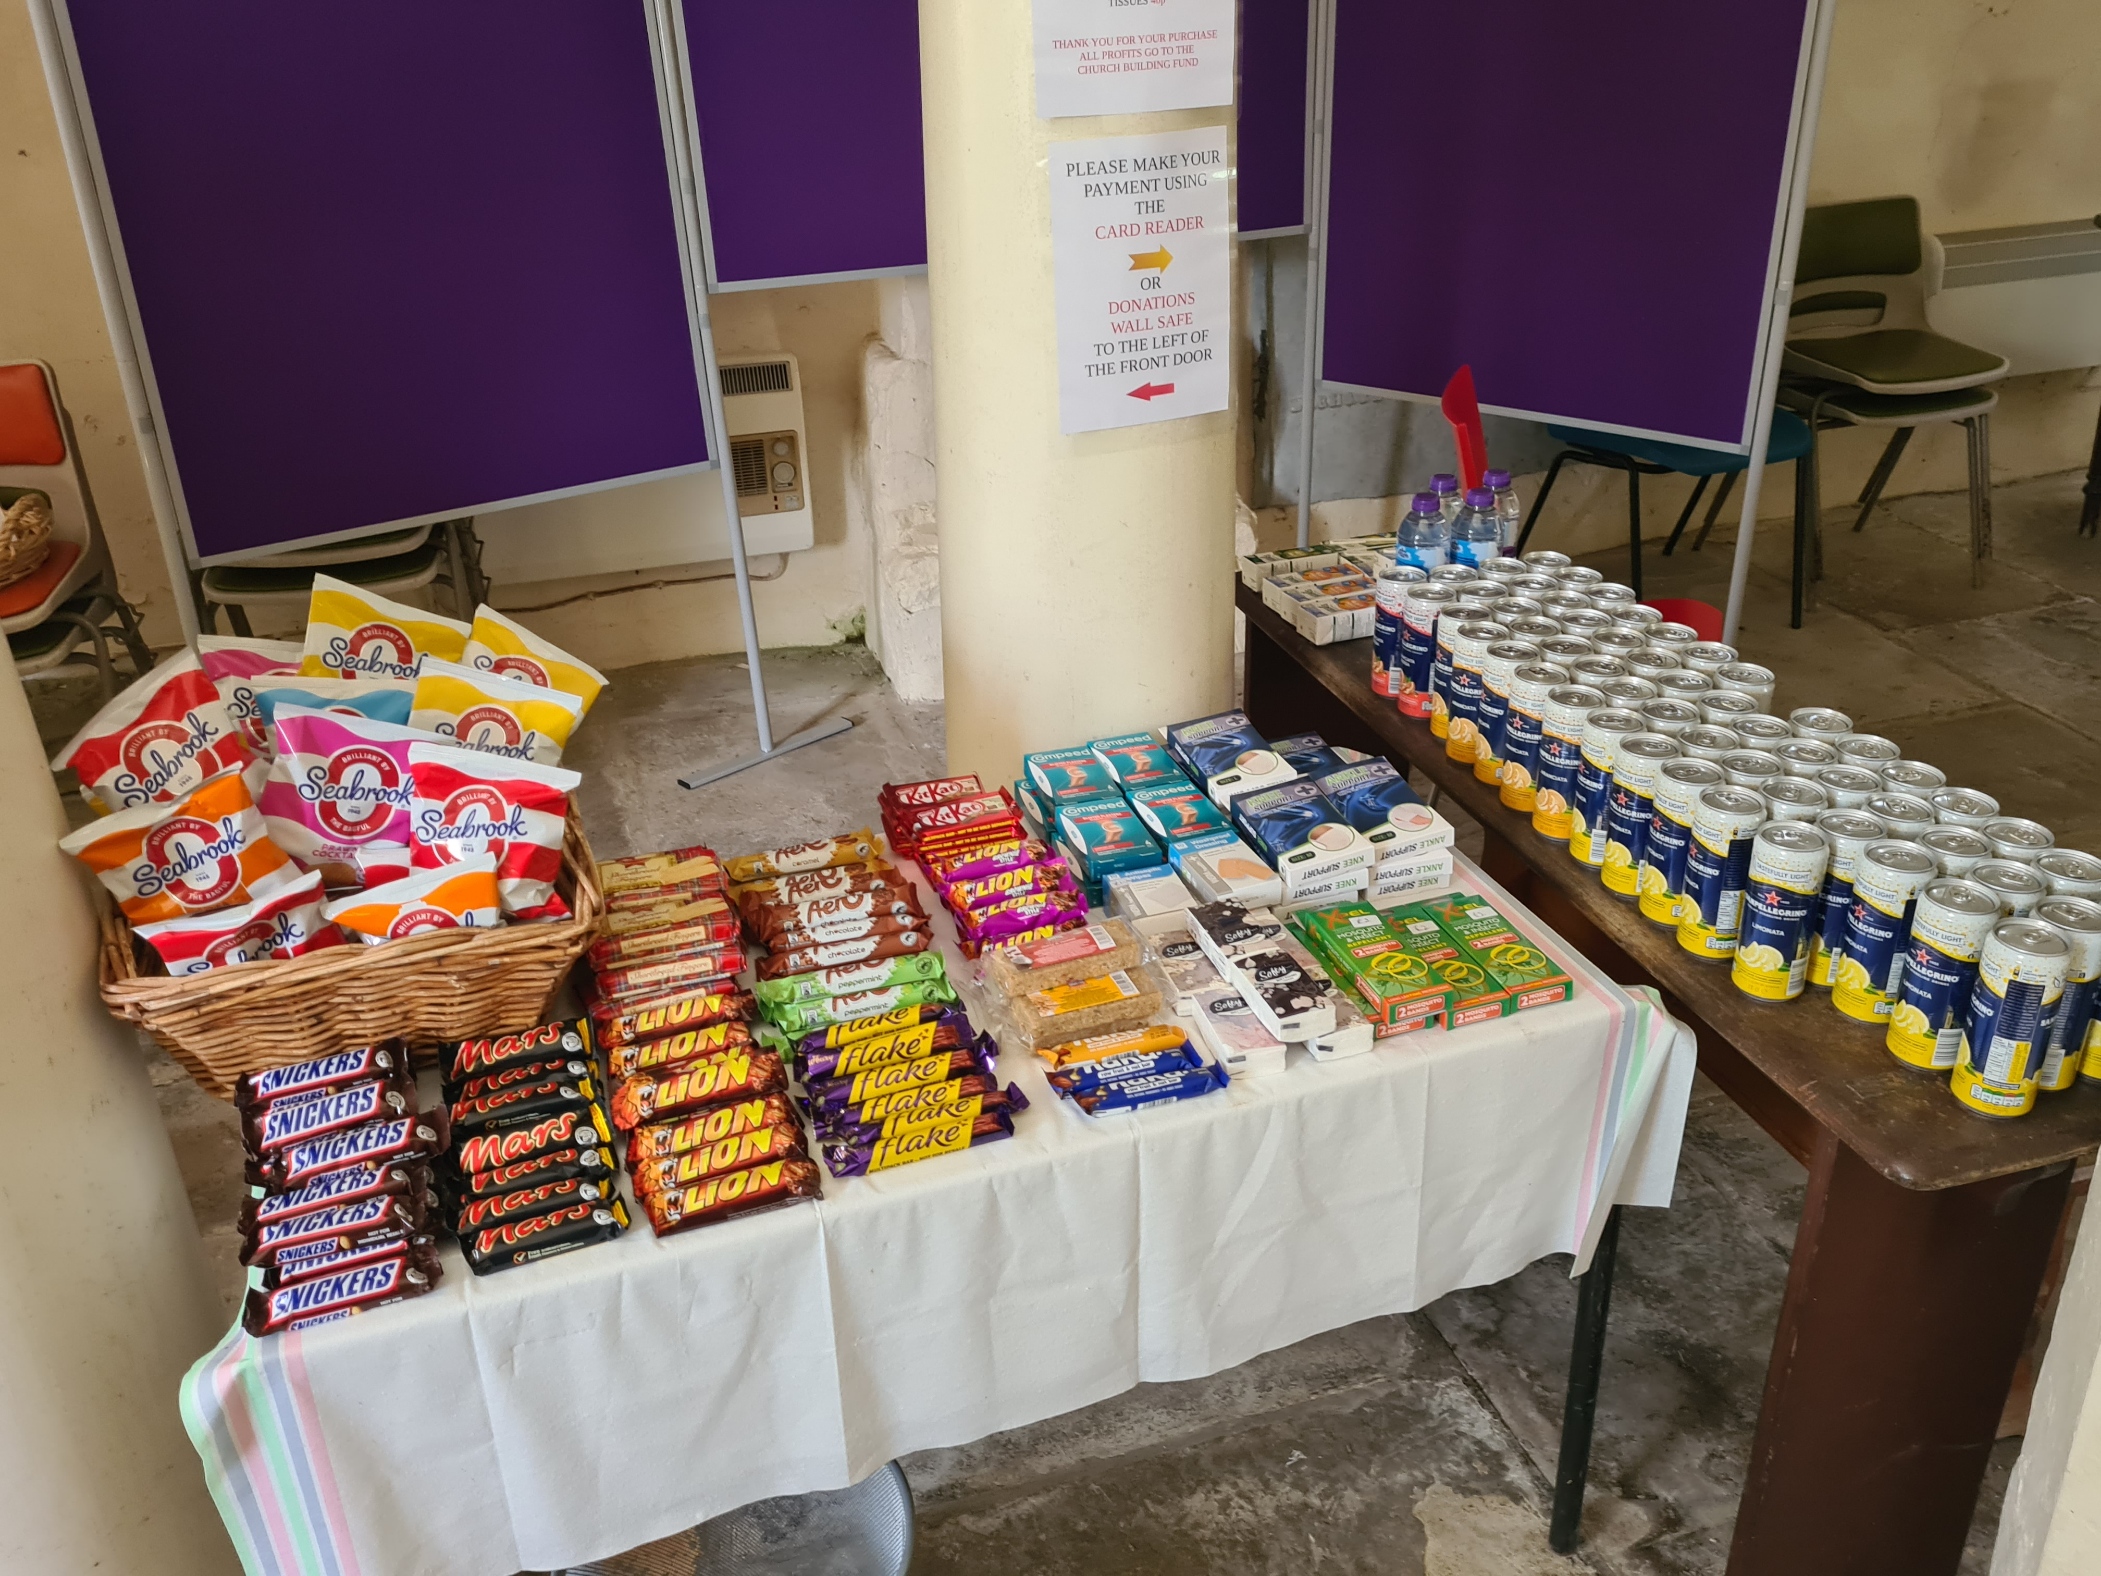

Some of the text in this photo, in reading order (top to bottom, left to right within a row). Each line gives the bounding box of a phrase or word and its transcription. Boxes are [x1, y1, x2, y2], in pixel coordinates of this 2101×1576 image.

[1052, 30, 1217, 49] THANK YOU FOR YOUR PURCHASE
[1080, 45, 1194, 61] ALL PROFITS GO TO THE
[1078, 58, 1198, 74] CHURCH BUILDING FUND
[1066, 150, 1220, 177] PLEASE MAKE YOUR
[1084, 173, 1207, 198] PAYMENT USING
[1134, 199, 1165, 215] THE
[1095, 215, 1205, 240] CARD READER
[1140, 276, 1162, 290] OR
[1108, 292, 1196, 314] DONATIONS
[1111, 312, 1193, 334] WALL SAFE
[1094, 329, 1209, 356] TO THE LEFT OF
[1085, 348, 1212, 377] THE FRONT DOOR
[362, 628, 399, 640] BRILLIANT
[470, 711, 507, 724] BRILLIANT
[128, 729, 156, 757] BRILLIANT
[1093, 735, 1152, 750] Compeed
[114, 712, 220, 808] Seabrook
[341, 752, 382, 764] BRILLIANT
[1030, 749, 1091, 763] Compeed
[299, 766, 415, 806] Seabrook
[900, 782, 961, 804] KitKat
[1134, 784, 1197, 801] Compeed
[1332, 774, 1371, 791] SUPPORT
[457, 792, 490, 805] BRILLIANT
[1062, 801, 1126, 816] Compeed
[1668, 801, 1686, 811] LIGHT
[330, 817, 342, 830] THE
[416, 804, 528, 843] Seabrook
[921, 801, 984, 826] KitKat
[151, 822, 201, 846] BRILLIANT BY
[1703, 828, 1720, 839] LIGHT
[133, 817, 246, 897] Seabrook
[964, 841, 1020, 863] LION
[1380, 834, 1445, 860] ANKLE SUPPORT
[792, 857, 819, 867] caramel
[1302, 855, 1364, 880] KNEE SUPPORT
[1374, 862, 1443, 880] ANKLE SUPPORT
[1756, 862, 1788, 879] TASTEFULLY
[188, 880, 232, 901] THE BAGFUL
[788, 877, 843, 903] Aero
[976, 865, 1034, 897] LION
[1293, 878, 1357, 898] KNEE SUPPORT
[1378, 877, 1438, 895] KNEE SUPPORT
[988, 893, 1048, 916] LION
[1745, 893, 1807, 917] NPELLEGRINO
[1876, 888, 1896, 900] LIGHT
[808, 893, 864, 924] Aero
[399, 914, 444, 935] BRILLIANT BY
[825, 925, 862, 936] chocolate
[1337, 925, 1385, 939] MOSQUITO
[1454, 918, 1500, 931] MOSQUITO
[1464, 927, 1508, 940] REPELLENT
[1471, 923, 1500, 933] INSECT
[1752, 922, 1785, 936] LIMONATA
[1848, 910, 1893, 939] PELLEGRINO
[1346, 934, 1392, 947] REPELLENT
[1354, 931, 1385, 941] INSECT
[1940, 933, 1963, 943] LIGHT
[828, 947, 866, 959] chocolate
[838, 975, 883, 989] peppermint
[1903, 980, 1932, 1000] LIMONATA
[1398, 1006, 1406, 1017] 2
[1407, 997, 1442, 1010] MOSQUITO
[1520, 996, 1529, 1006] 2
[1529, 987, 1563, 999] MOSQUITO
[1529, 995, 1551, 1005] BANDS
[635, 993, 725, 1033] LION
[844, 1002, 890, 1017] peppermint
[1407, 1006, 1429, 1016] BANDS
[1456, 1005, 1499, 1024] 2 MOSQUITO
[1465, 1013, 1487, 1022] BANDS
[835, 1005, 909, 1045] flake
[1379, 1024, 1387, 1035] 2
[1388, 1024, 1410, 1033] BANDS
[451, 1022, 564, 1080] Mars
[637, 1021, 729, 1068] LION
[846, 1034, 920, 1078] flake
[261, 1049, 366, 1096] SNICKERS
[460, 1058, 566, 1101] Mars
[656, 1054, 751, 1108] LION
[860, 1058, 938, 1101] flake
[271, 1088, 326, 1108] SNICKERS
[450, 1081, 558, 1124] Mars
[871, 1084, 948, 1120] flake
[264, 1086, 376, 1143] SNICKERS
[892, 1100, 970, 1136] flake
[670, 1099, 766, 1154] LION
[291, 1121, 406, 1174] SNICKERS
[460, 1112, 577, 1174] Mars
[880, 1125, 960, 1167] flake
[676, 1127, 774, 1183] LION
[309, 1163, 364, 1188] SNICKERS
[262, 1167, 383, 1216] SNICKERS
[682, 1159, 786, 1215] LION
[458, 1177, 583, 1230] Mars
[264, 1201, 383, 1242] SNICKERS
[475, 1200, 596, 1253] Mars
[277, 1238, 336, 1263] SNICKERS
[274, 1261, 397, 1318] SNICKERS
